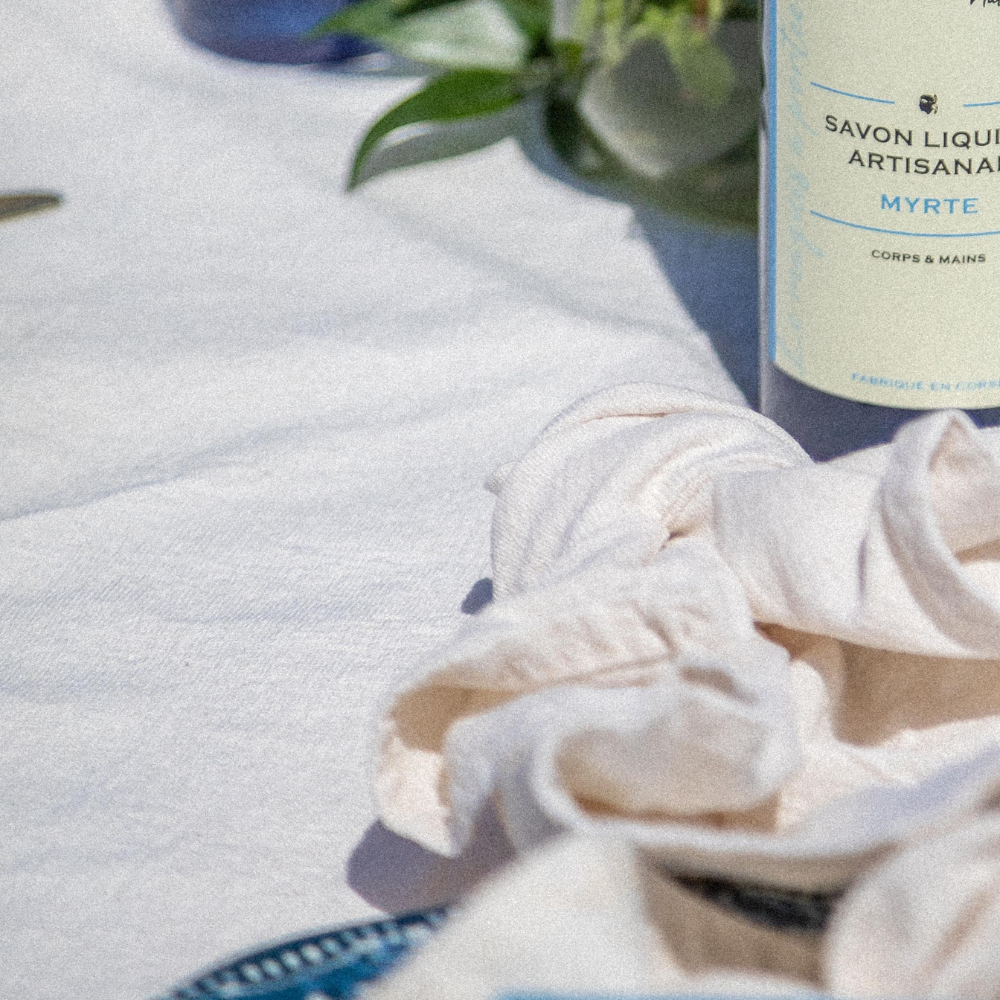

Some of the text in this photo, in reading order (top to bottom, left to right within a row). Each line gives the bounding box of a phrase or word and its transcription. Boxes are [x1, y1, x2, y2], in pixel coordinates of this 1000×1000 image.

[825, 114, 913, 147] SAVON
[880, 193, 980, 215] MYRTE
[871, 249, 987, 264] CORPS & MAINS
